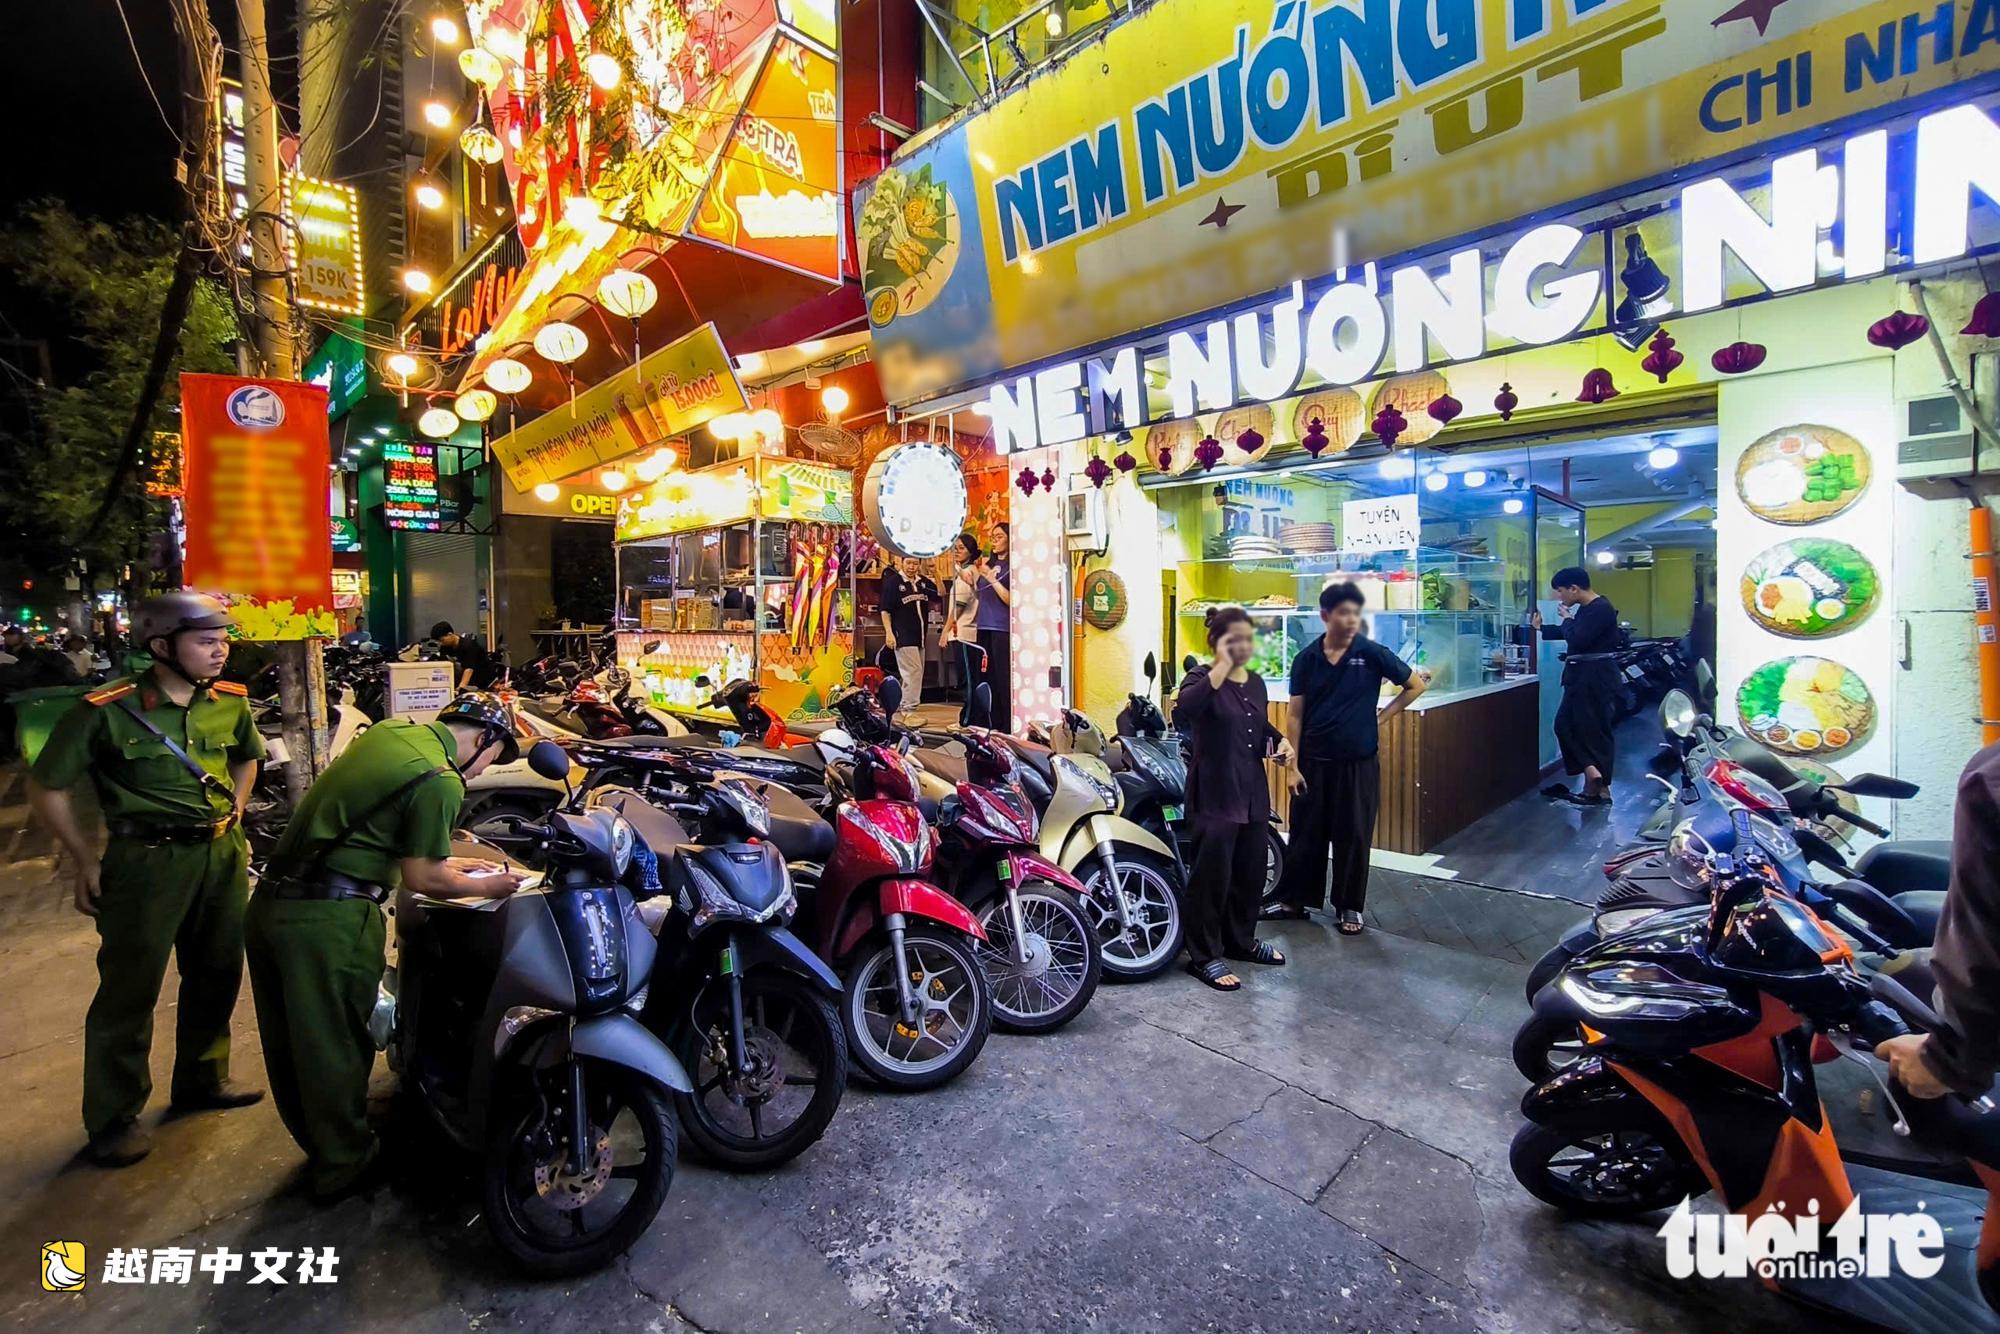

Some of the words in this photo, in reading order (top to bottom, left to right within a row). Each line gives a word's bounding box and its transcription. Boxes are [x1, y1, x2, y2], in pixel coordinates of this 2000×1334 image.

[1699, 51, 1811, 133] CHI
[994, 122, 1127, 264] NEM
[306, 264, 348, 290] 159K
[989, 346, 1142, 456] NEM
[1168, 224, 1600, 418] NƯỚNG
